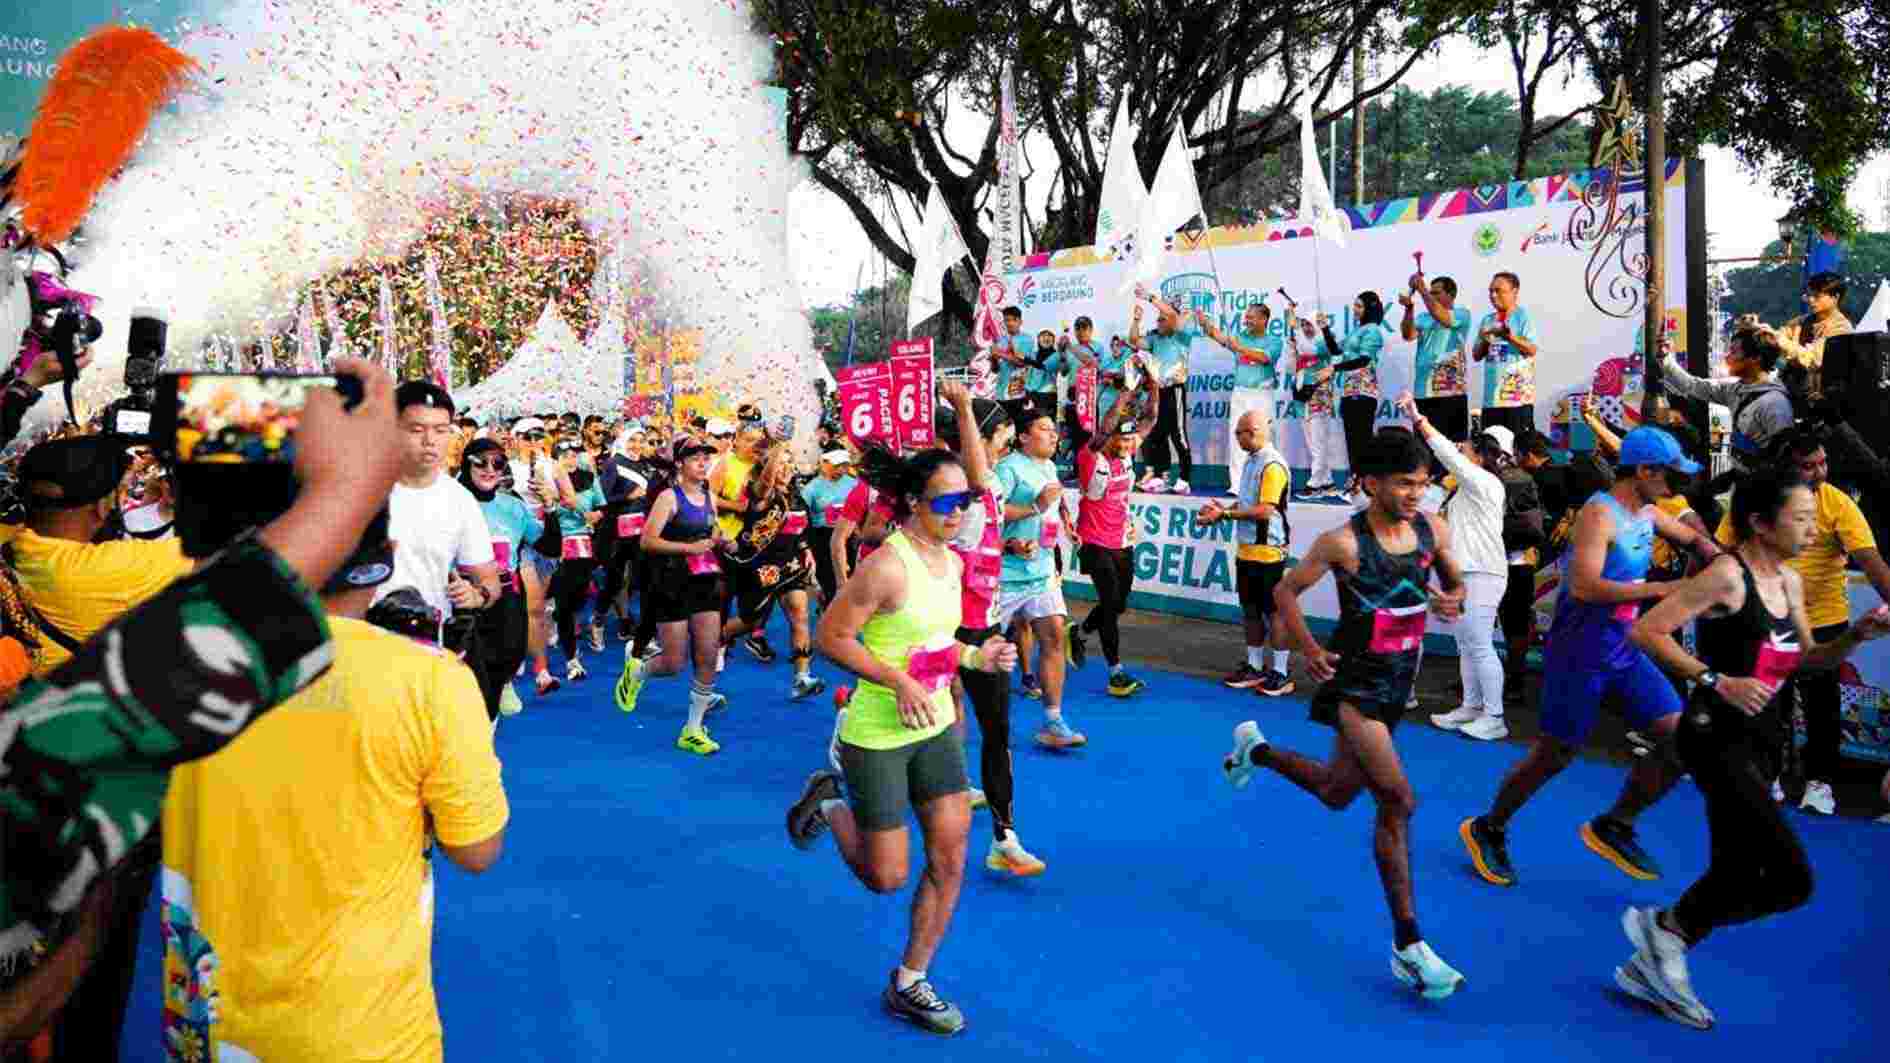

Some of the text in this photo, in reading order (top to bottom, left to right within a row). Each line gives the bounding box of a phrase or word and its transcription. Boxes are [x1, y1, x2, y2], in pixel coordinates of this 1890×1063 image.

[1221, 289, 1269, 310] Tidar
[897, 383, 915, 423] 6
[918, 369, 929, 424] PACER
[850, 402, 874, 438] 6
